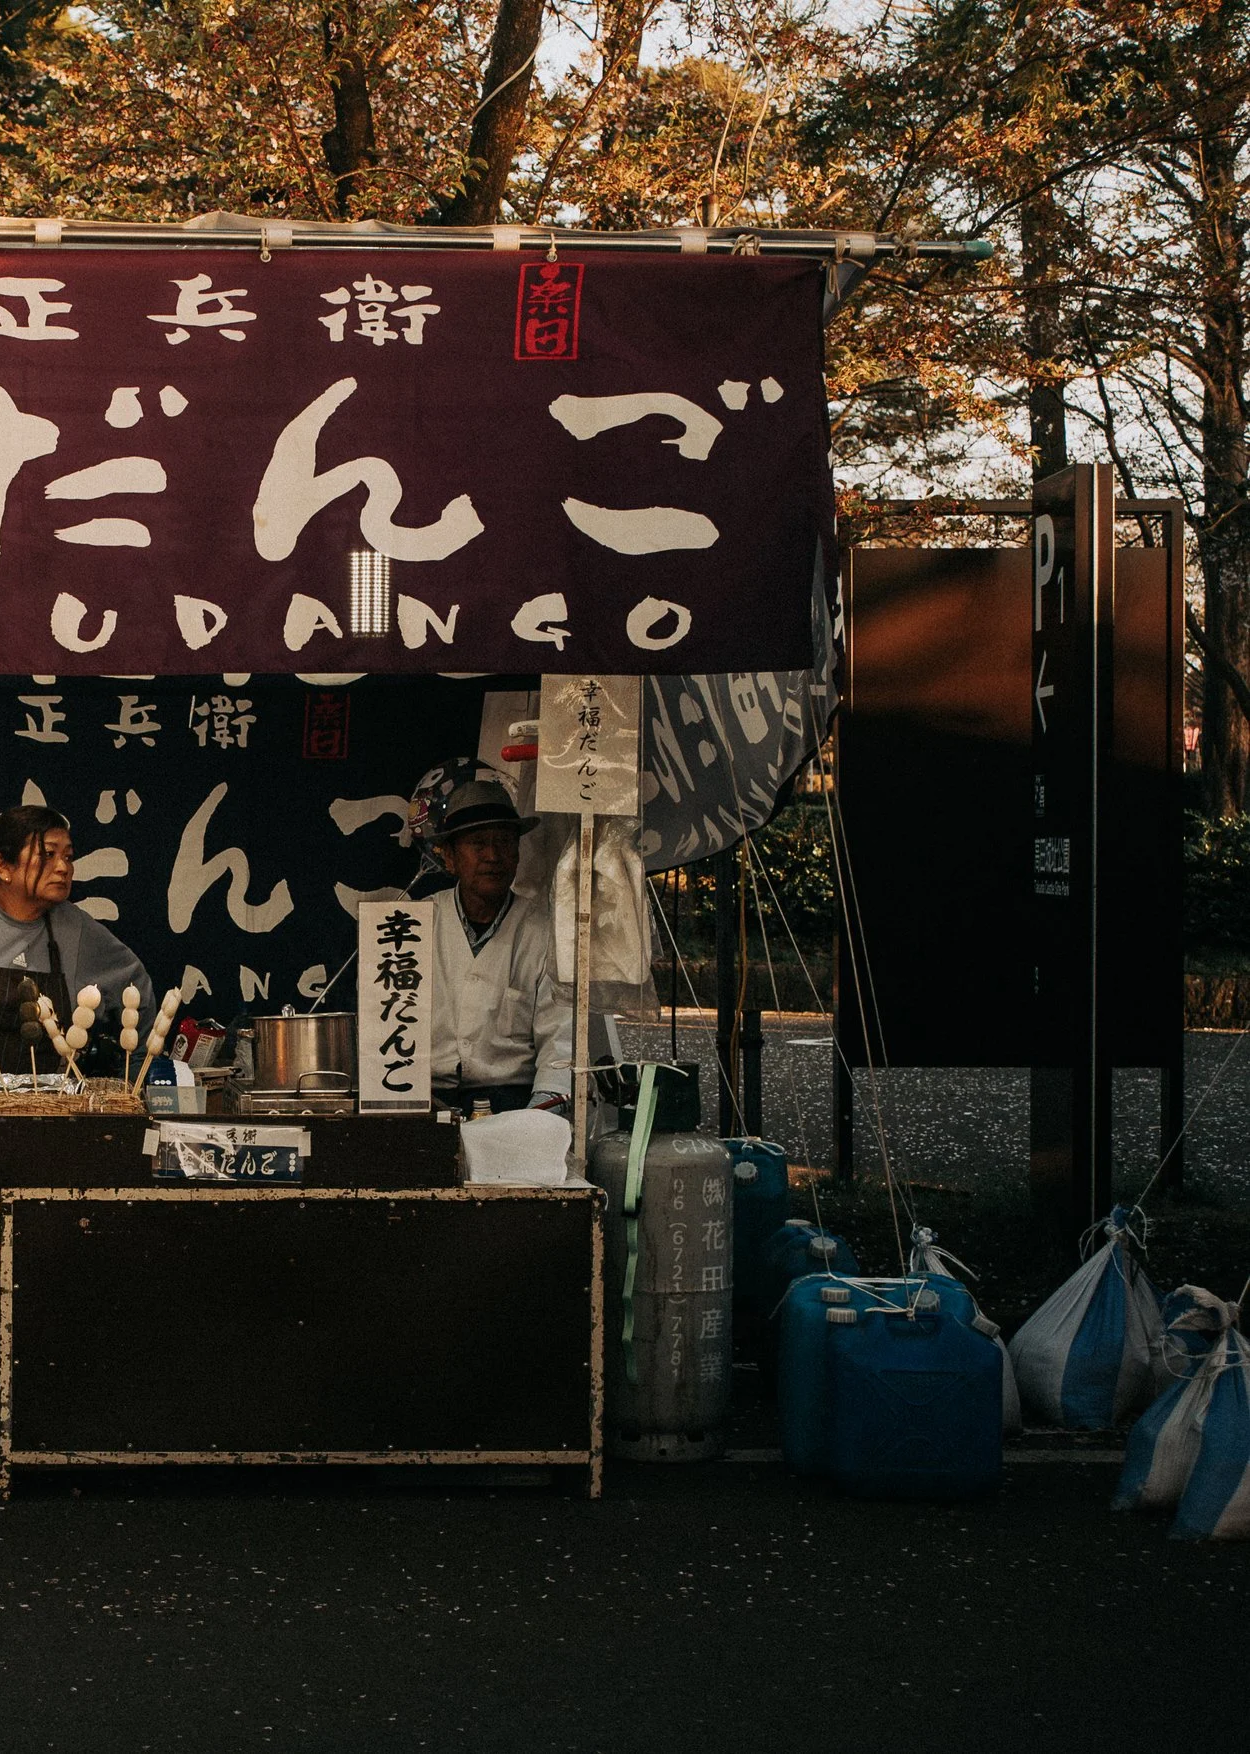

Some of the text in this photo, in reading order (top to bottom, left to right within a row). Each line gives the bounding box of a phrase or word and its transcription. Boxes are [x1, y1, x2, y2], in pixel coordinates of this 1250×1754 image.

[577, 680, 602, 800] 幸福だんご
[374, 909, 423, 1092] 幸福だんご
